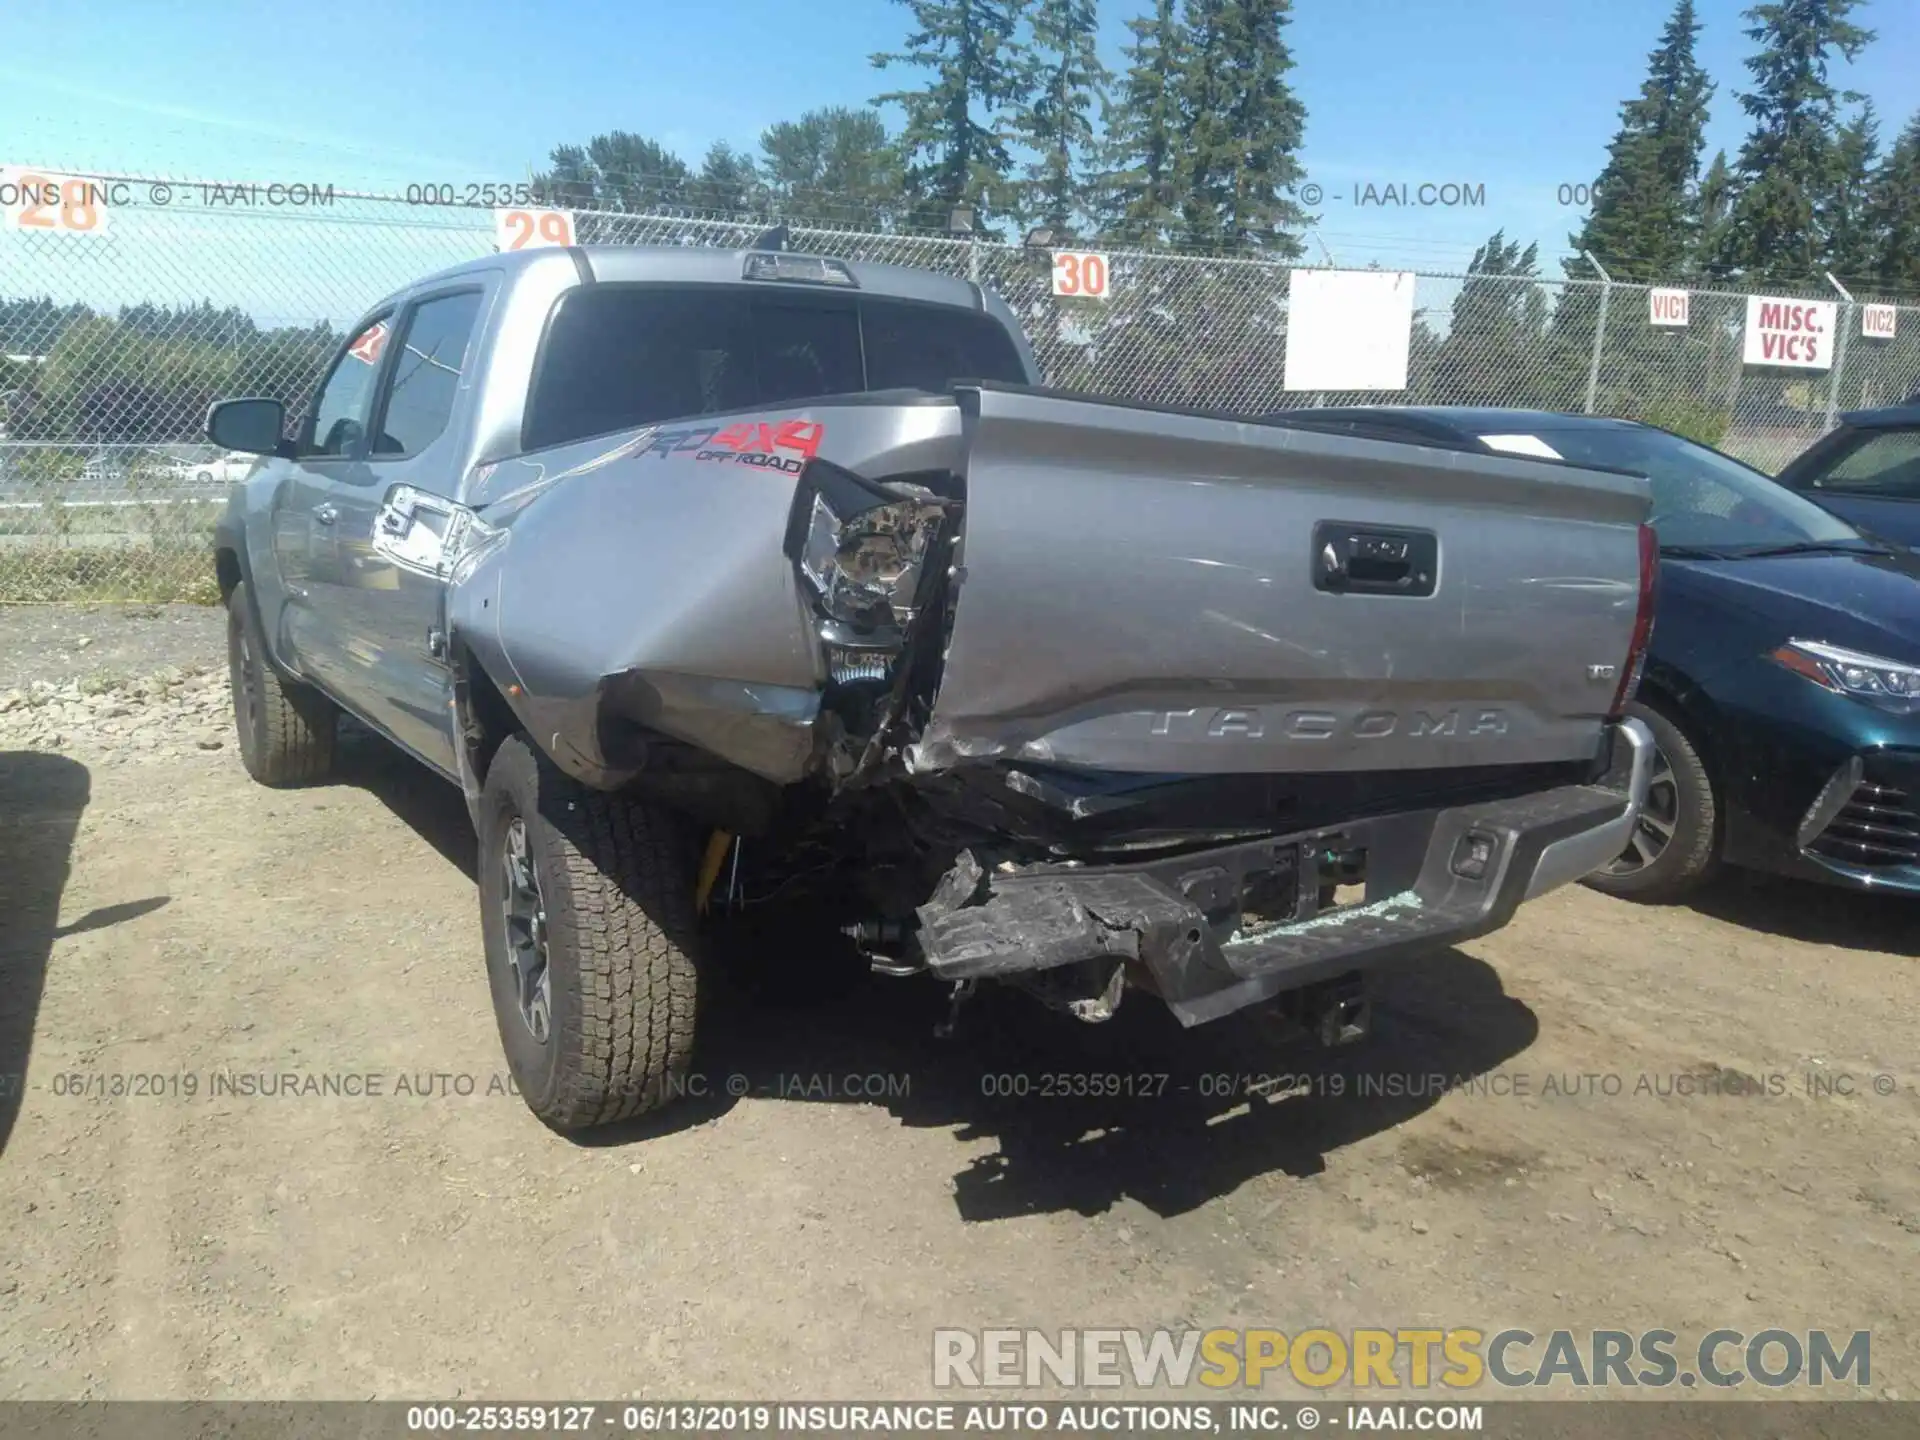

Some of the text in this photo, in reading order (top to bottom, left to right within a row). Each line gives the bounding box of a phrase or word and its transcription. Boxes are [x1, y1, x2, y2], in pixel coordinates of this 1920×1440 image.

[18, 174, 97, 231] 28
[505, 211, 572, 250] 29
[1058, 255, 1104, 295] 30
[1653, 294, 1686, 320] VIC1
[1759, 302, 1824, 333] MISC.
[1865, 309, 1893, 332] VIC2
[1761, 332, 1818, 362] VIC'S
[696, 450, 803, 474] OFF ROAD
[1136, 706, 1508, 740] TACOMA
